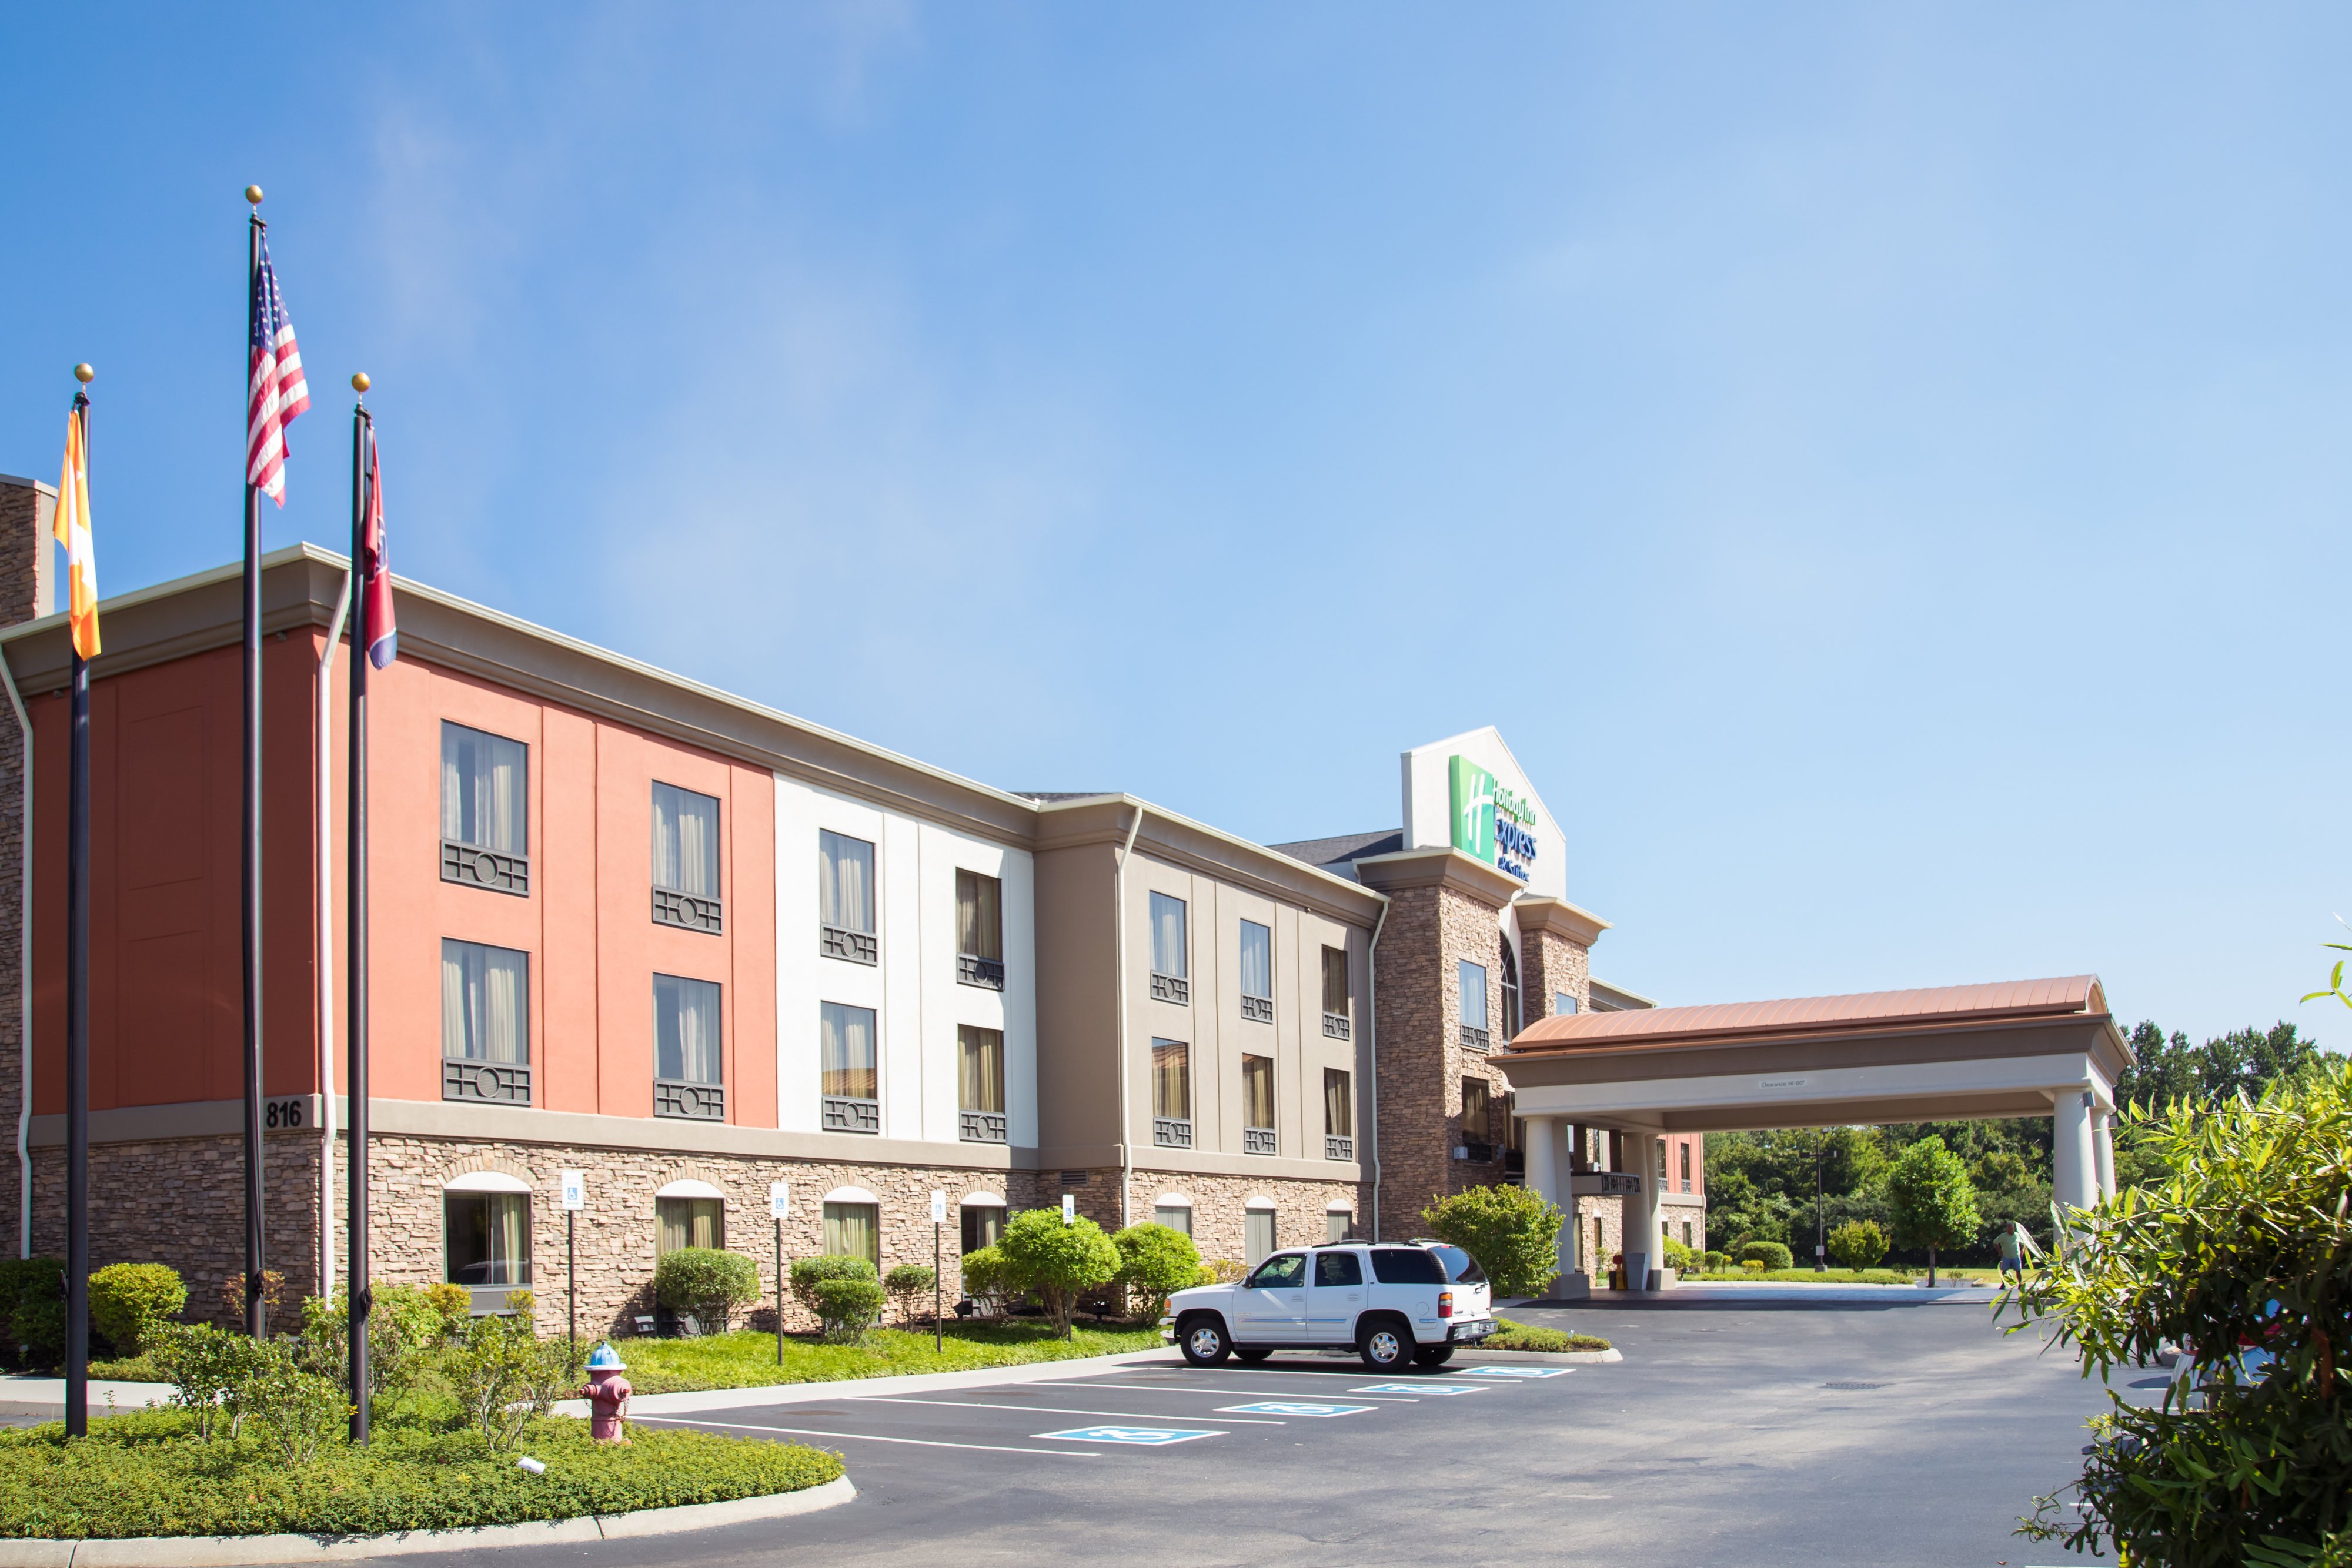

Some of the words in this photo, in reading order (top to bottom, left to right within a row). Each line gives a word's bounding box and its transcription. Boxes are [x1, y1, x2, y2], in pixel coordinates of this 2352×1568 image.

[1493, 778, 1525, 822] Holiday
[1522, 798, 1536, 825] Inn
[1494, 805, 1537, 860] Express
[1498, 855, 1508, 872] &
[1506, 860, 1529, 882] Suites
[266, 1100, 302, 1128] 816
